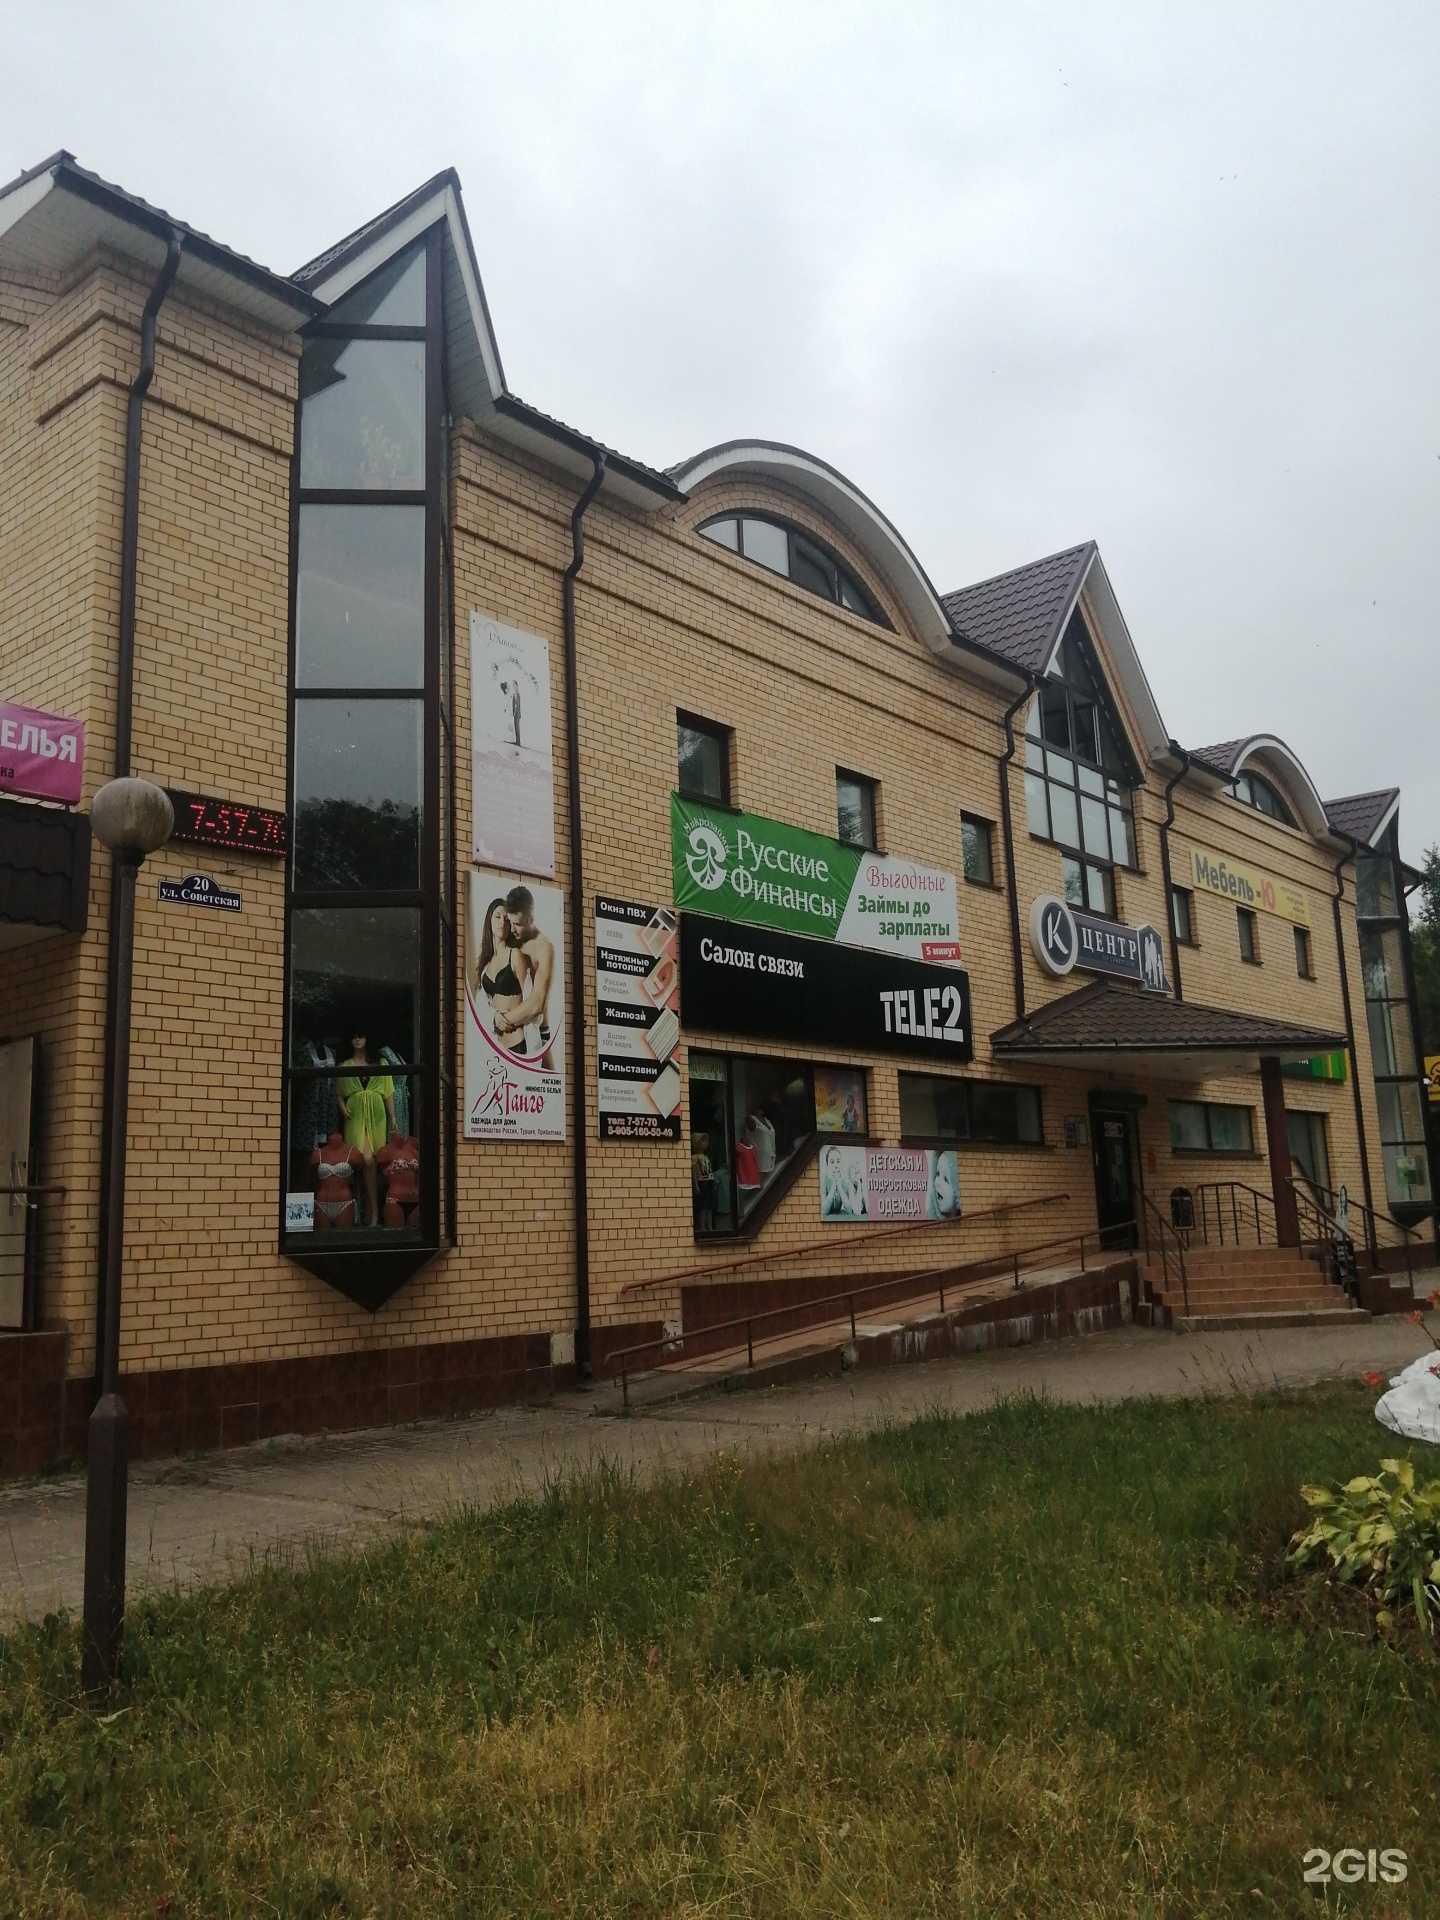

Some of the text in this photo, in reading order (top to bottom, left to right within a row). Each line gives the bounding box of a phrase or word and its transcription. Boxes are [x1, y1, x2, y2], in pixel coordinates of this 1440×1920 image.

[737, 829, 829, 882] Русские
[193, 877, 210, 892] 20
[866, 864, 945, 893] Выгодные
[161, 887, 239, 908] ул. Советская
[730, 864, 837, 919] Финансы
[600, 901, 647, 919] Окна ПВХ
[857, 894, 931, 918] Займы до
[878, 921, 950, 941] зарплаты
[932, 946, 957, 958] минут
[1081, 927, 1137, 961] ЦЕНТР
[600, 950, 650, 967] Натяжные
[606, 960, 645, 974] потолки
[700, 937, 805, 978] Салон связи
[879, 985, 964, 1043] TELE2
[602, 1062, 658, 1075] Рольставни
[503, 1082, 544, 1116] Танго
[471, 1117, 491, 1125] ОДЕЖДА
[504, 1118, 517, 1126] ДОМА
[869, 1152, 924, 1173] ДЕТСКАЯ И
[868, 1177, 928, 1193] ПОДРОСТКОВАЯ
[879, 1198, 921, 1217] ОДЕЖДА
